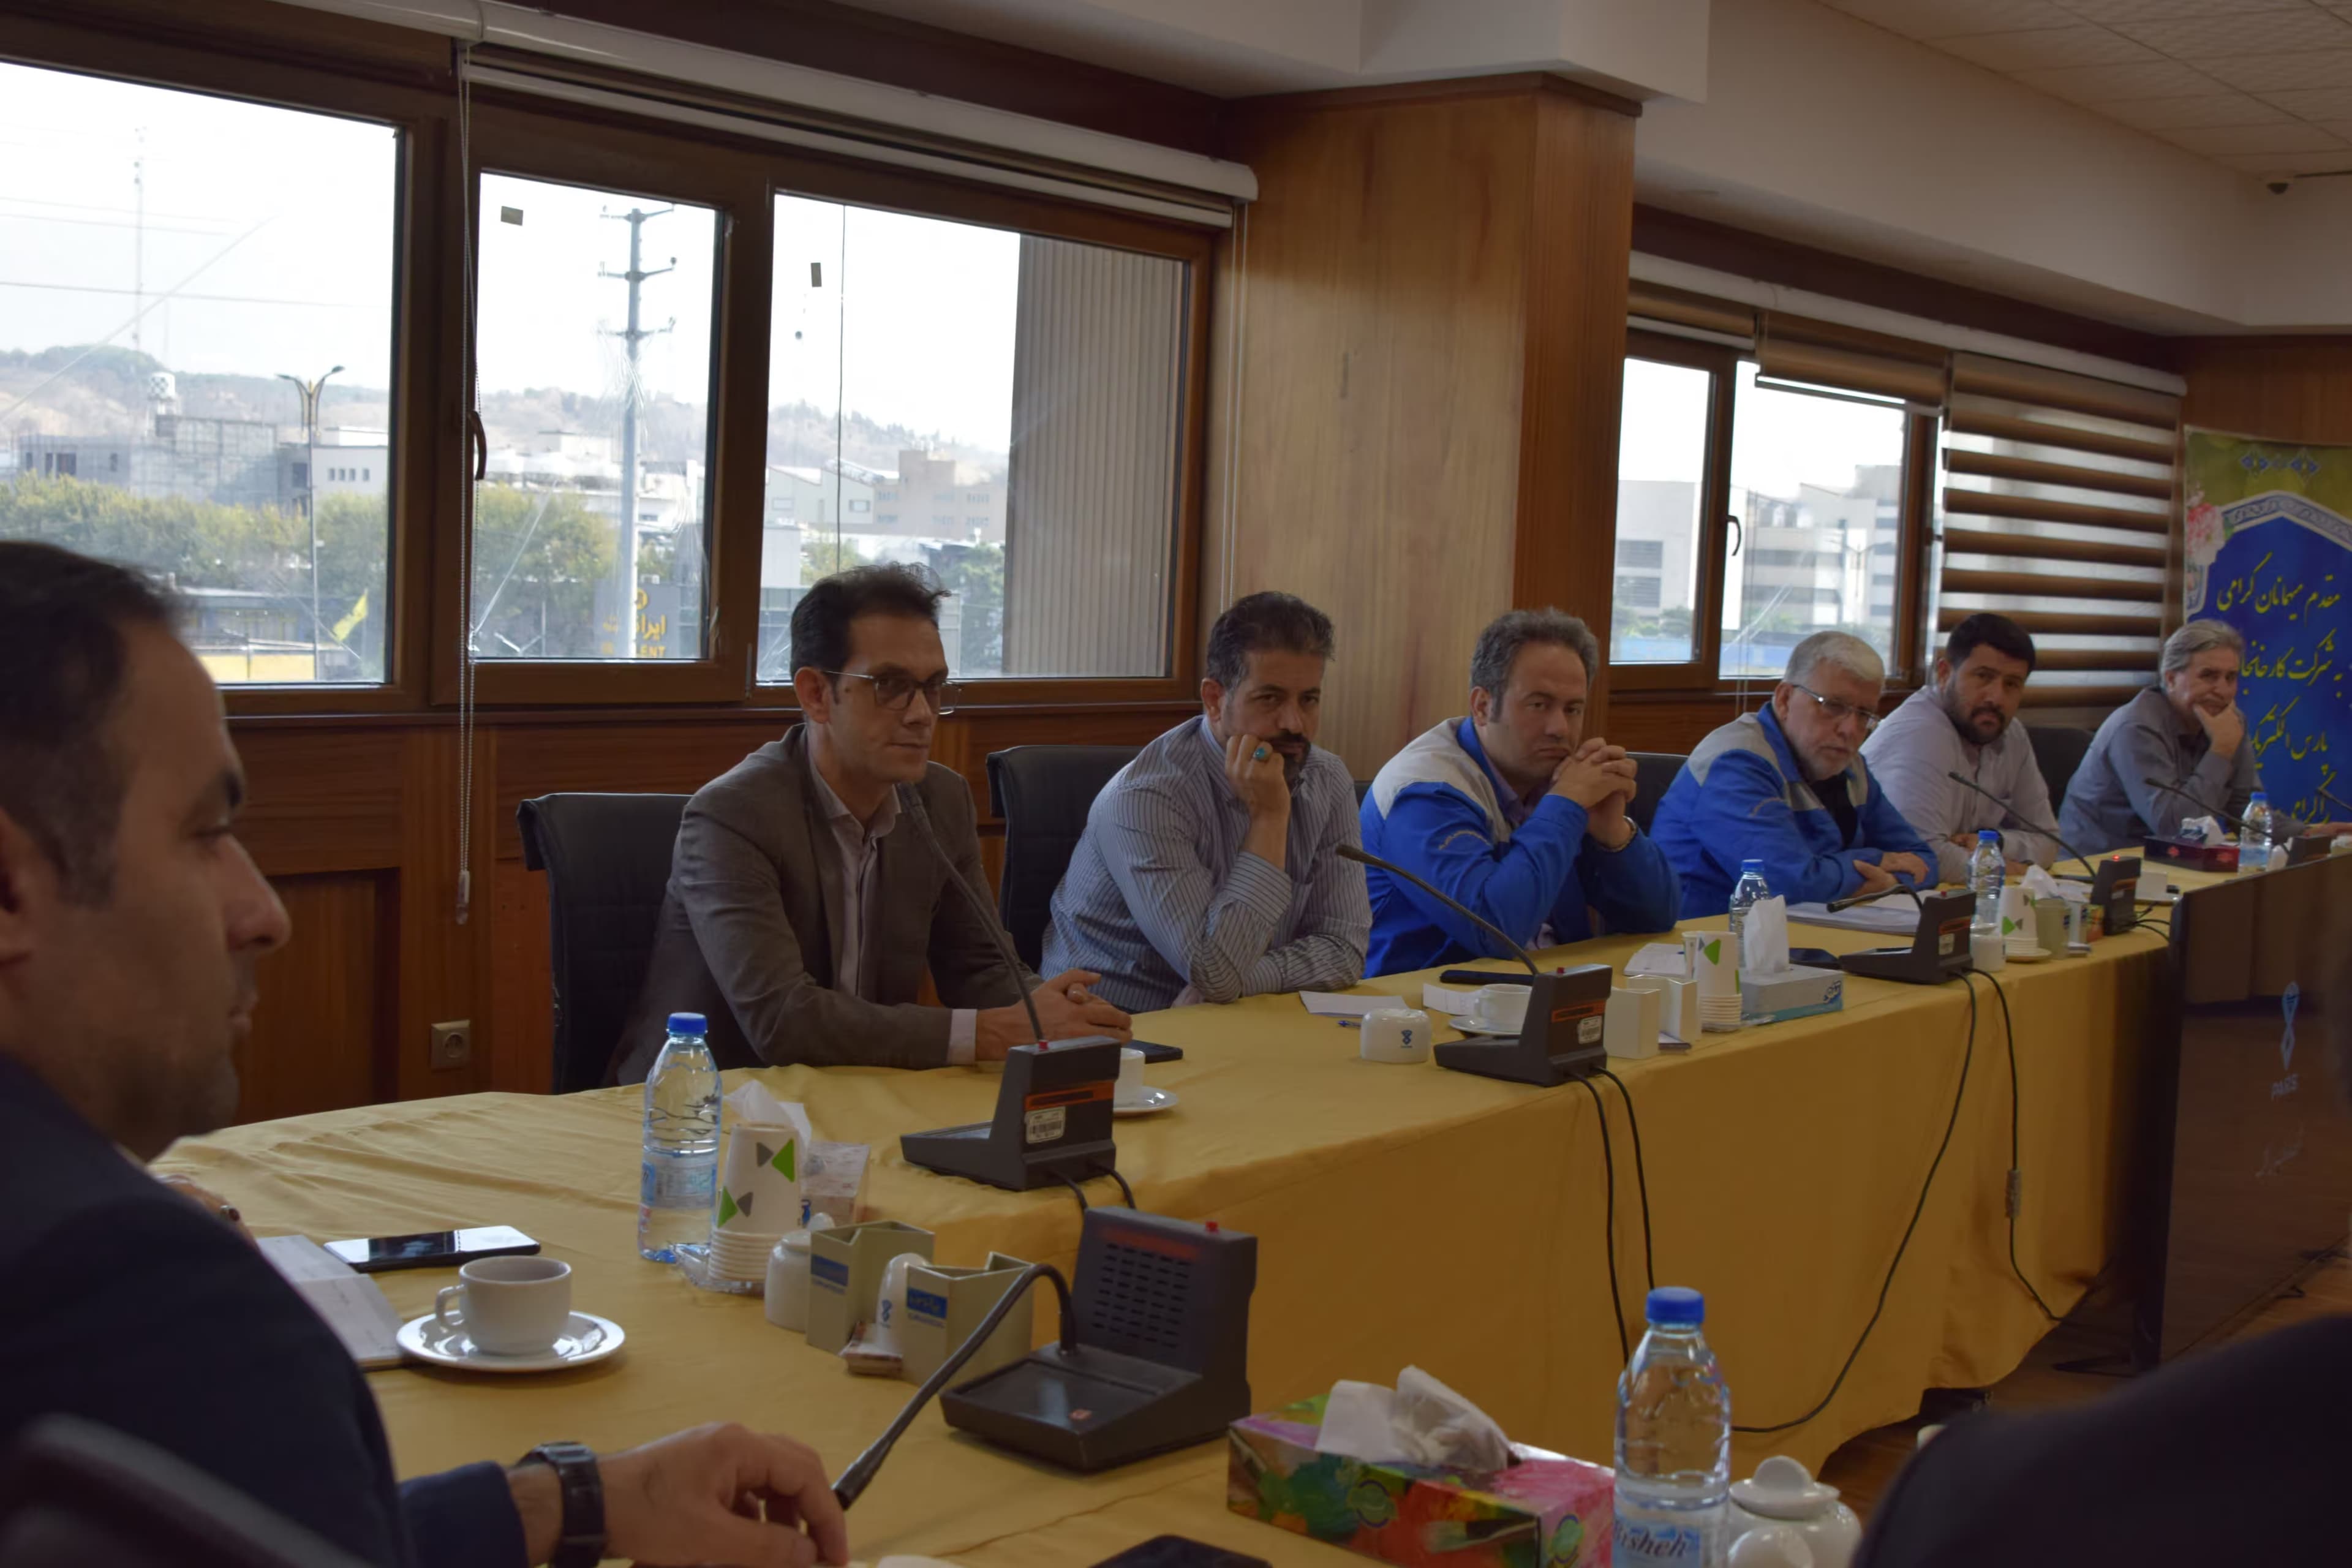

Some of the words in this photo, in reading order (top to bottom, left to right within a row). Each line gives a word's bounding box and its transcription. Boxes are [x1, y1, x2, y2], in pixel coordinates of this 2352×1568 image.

[2255, 576, 2303, 620] میهمانان
[2305, 575, 2340, 627] مقدم
[2241, 641, 2294, 696] کارخانجا
[2288, 628, 2336, 686] شرکت
[2291, 731, 2328, 775] پارس
